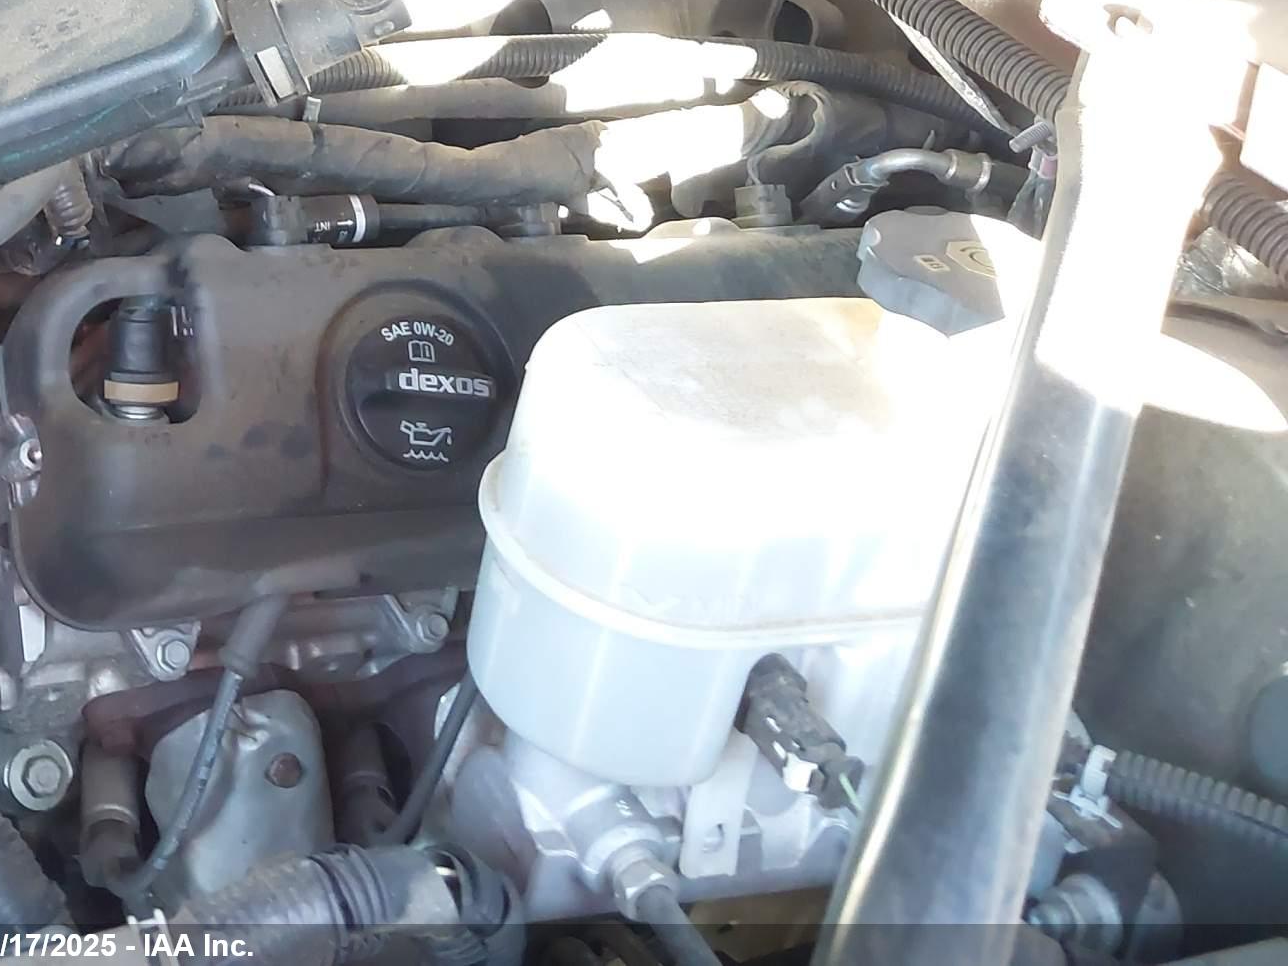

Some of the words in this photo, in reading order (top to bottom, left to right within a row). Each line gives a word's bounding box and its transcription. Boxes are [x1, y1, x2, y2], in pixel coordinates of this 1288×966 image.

[380, 321, 412, 342] SAE
[413, 321, 455, 346] 0W-20
[398, 367, 490, 397] dexos
